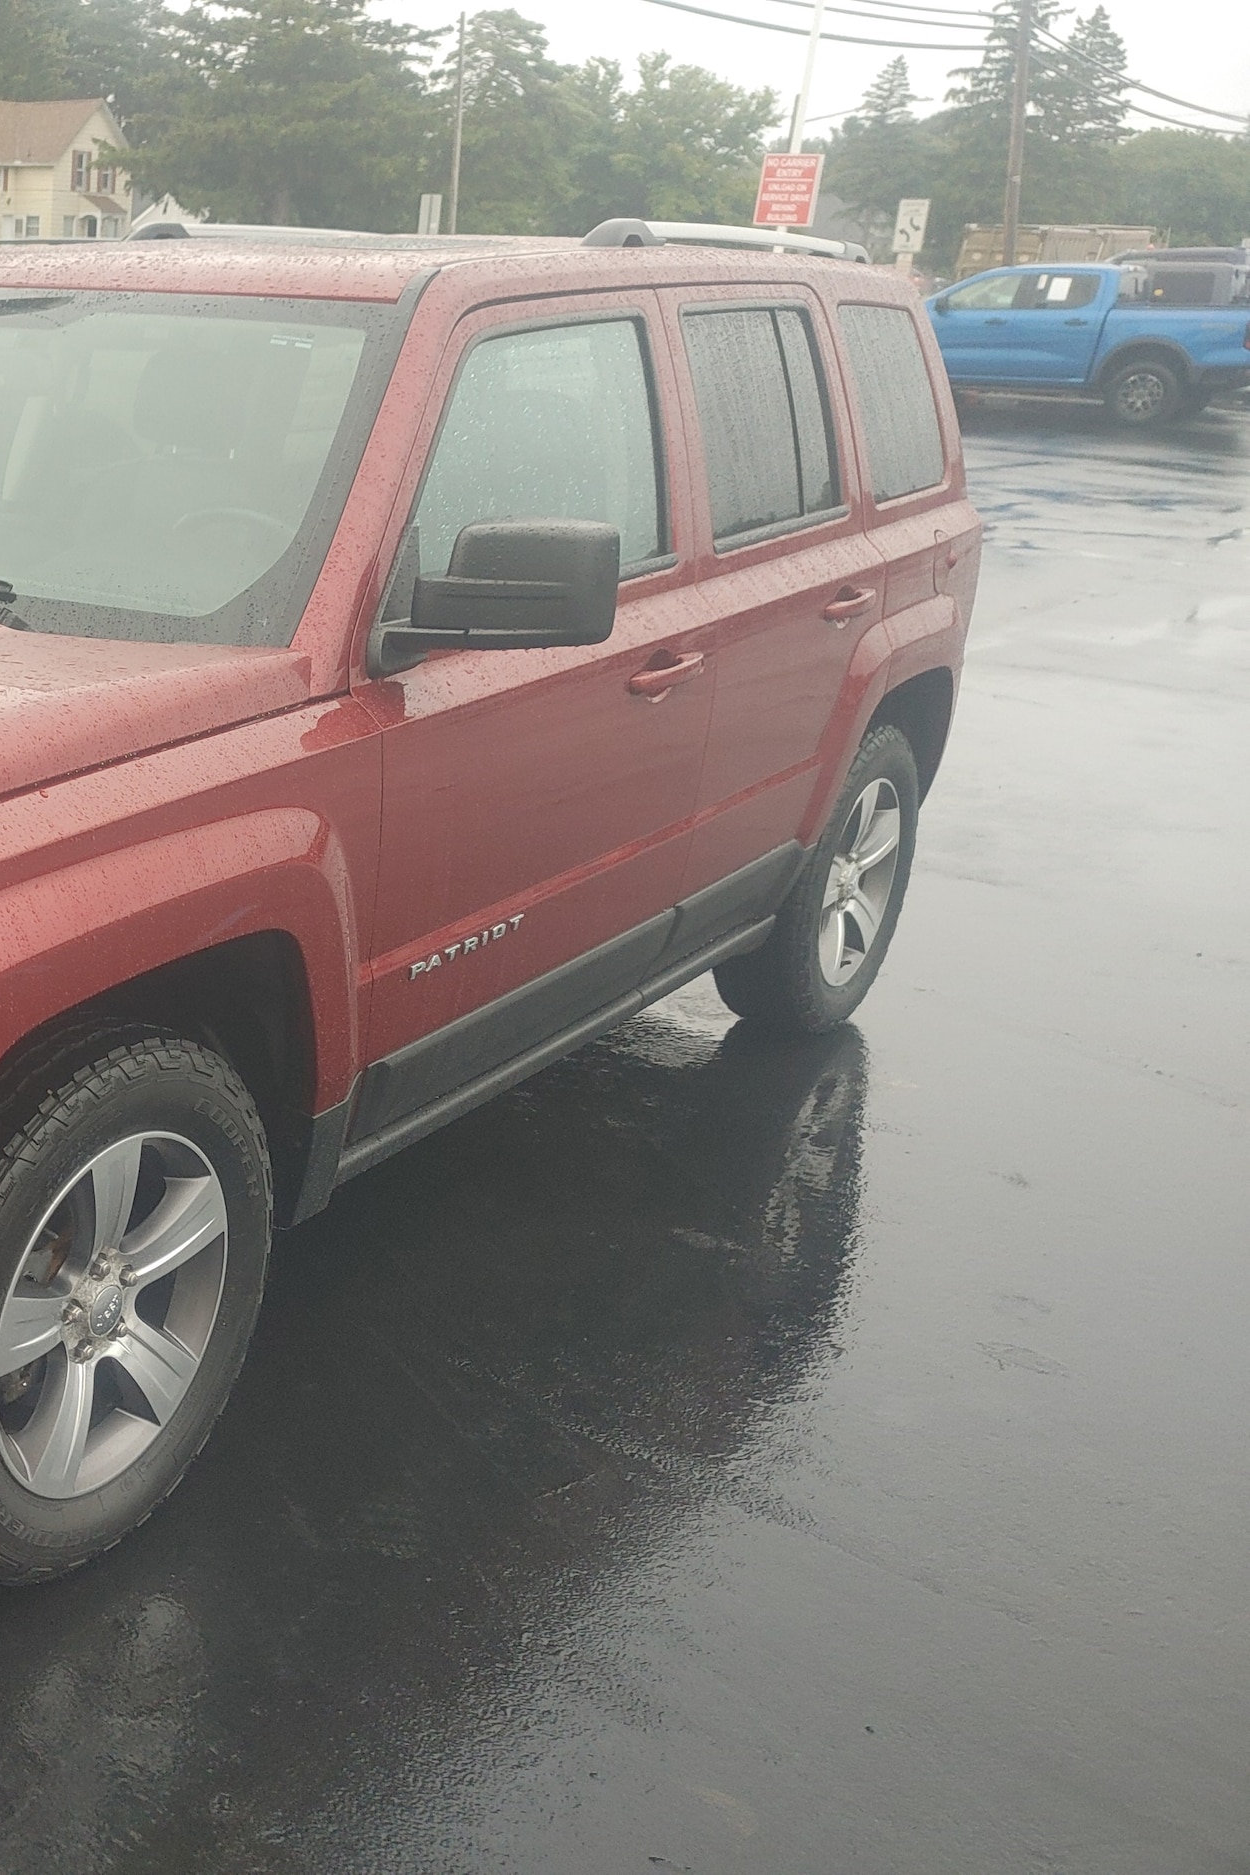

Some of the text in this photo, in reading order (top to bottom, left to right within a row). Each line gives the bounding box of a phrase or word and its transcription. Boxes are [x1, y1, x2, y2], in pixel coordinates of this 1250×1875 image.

[767, 158, 817, 168] NO CARRIER
[776, 168, 804, 177] ENTRY
[767, 183, 796, 191] UNLOAD
[761, 193, 789, 201] SERVICE
[409, 913, 525, 981] PATRIOT
[193, 1096, 261, 1199] COOPER
